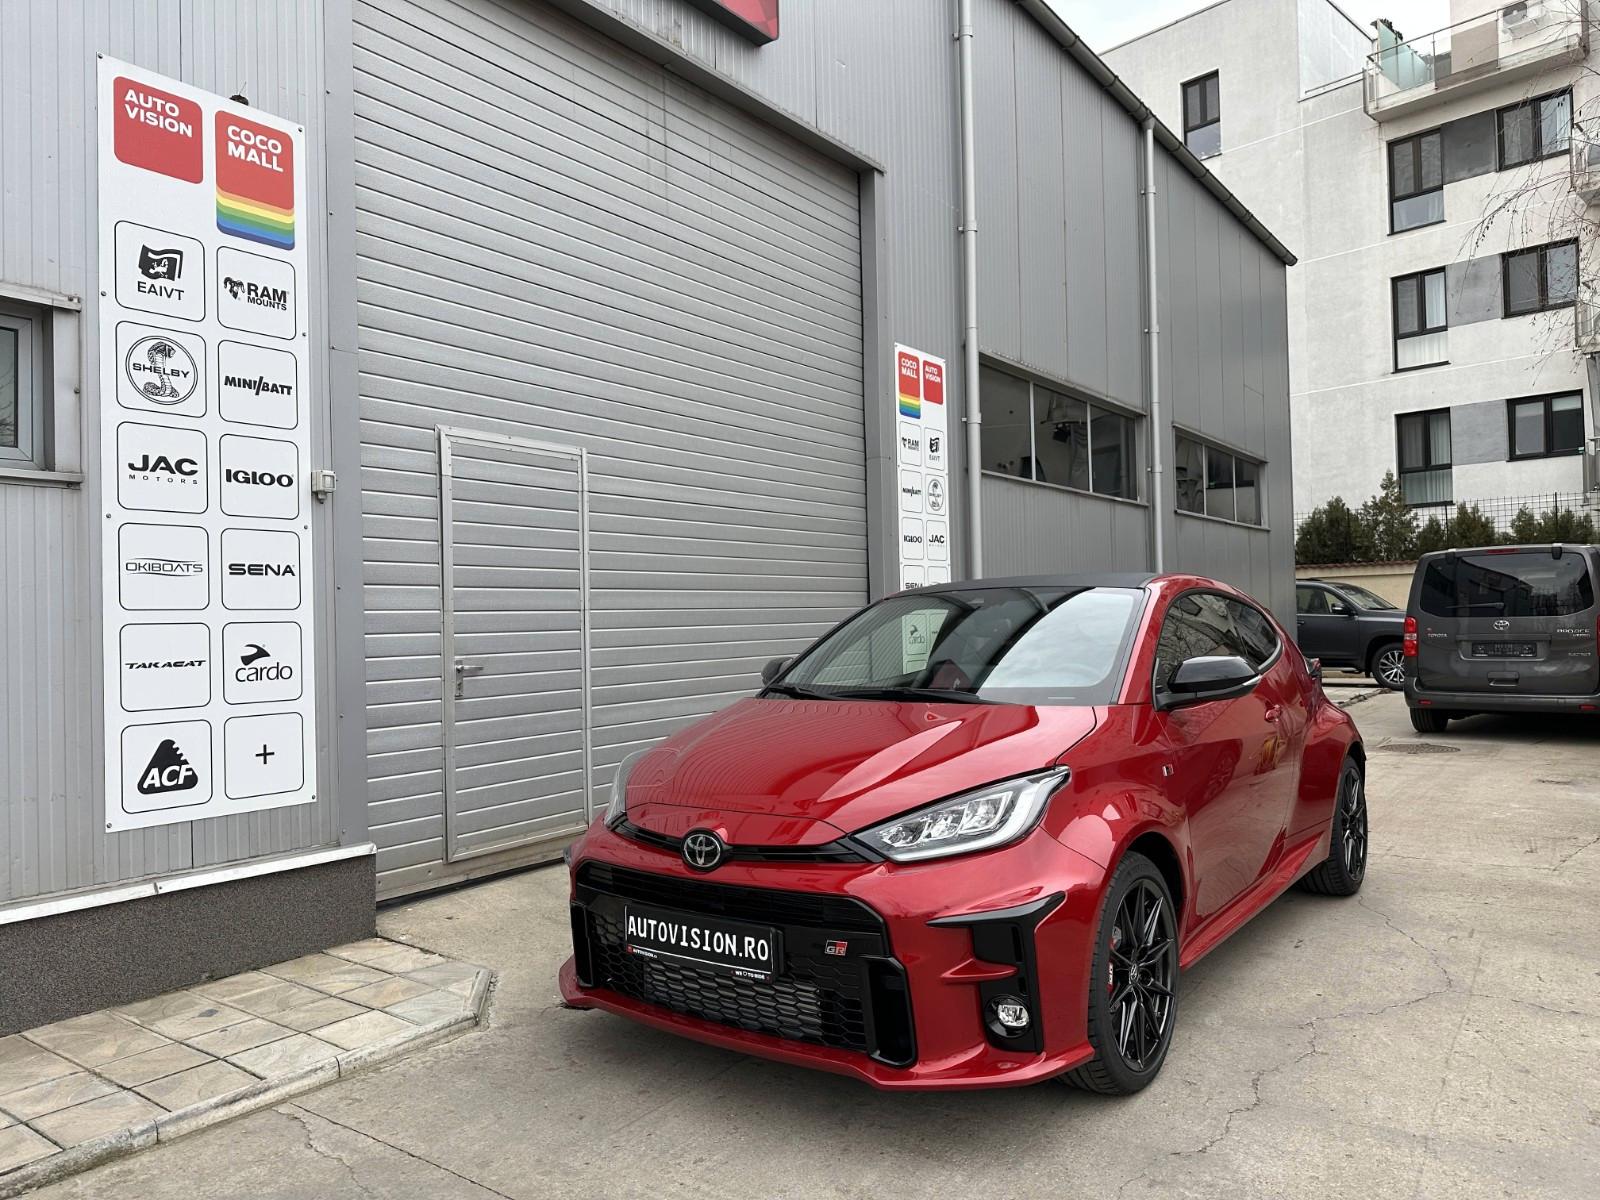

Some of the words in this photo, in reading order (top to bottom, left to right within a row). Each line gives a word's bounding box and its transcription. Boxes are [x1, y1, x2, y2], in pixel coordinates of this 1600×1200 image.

[125, 89, 180, 117] AUTO
[125, 103, 193, 138] VISION
[227, 125, 282, 154] COCO
[227, 141, 284, 173] MALL
[137, 280, 185, 301] EAIVT
[247, 283, 288, 304] RAM
[247, 295, 288, 311] MOUNTS
[132, 362, 190, 379] SHELBY
[901, 358, 917, 370] COCO
[901, 366, 918, 379] MALL
[925, 364, 938, 375] AUTO
[127, 454, 198, 476] JAC
[128, 474, 198, 485] MOTORS
[225, 468, 294, 488] IGLOO
[903, 535, 923, 544] IGLOO
[928, 535, 945, 544] JAC
[125, 561, 203, 574] OKIBOATS
[228, 563, 296, 576] SENA
[125, 660, 206, 669] TAKACAT
[235, 662, 293, 682] cardo
[143, 764, 193, 788] ACF
[627, 915, 769, 961] AUTOVISION.RO
